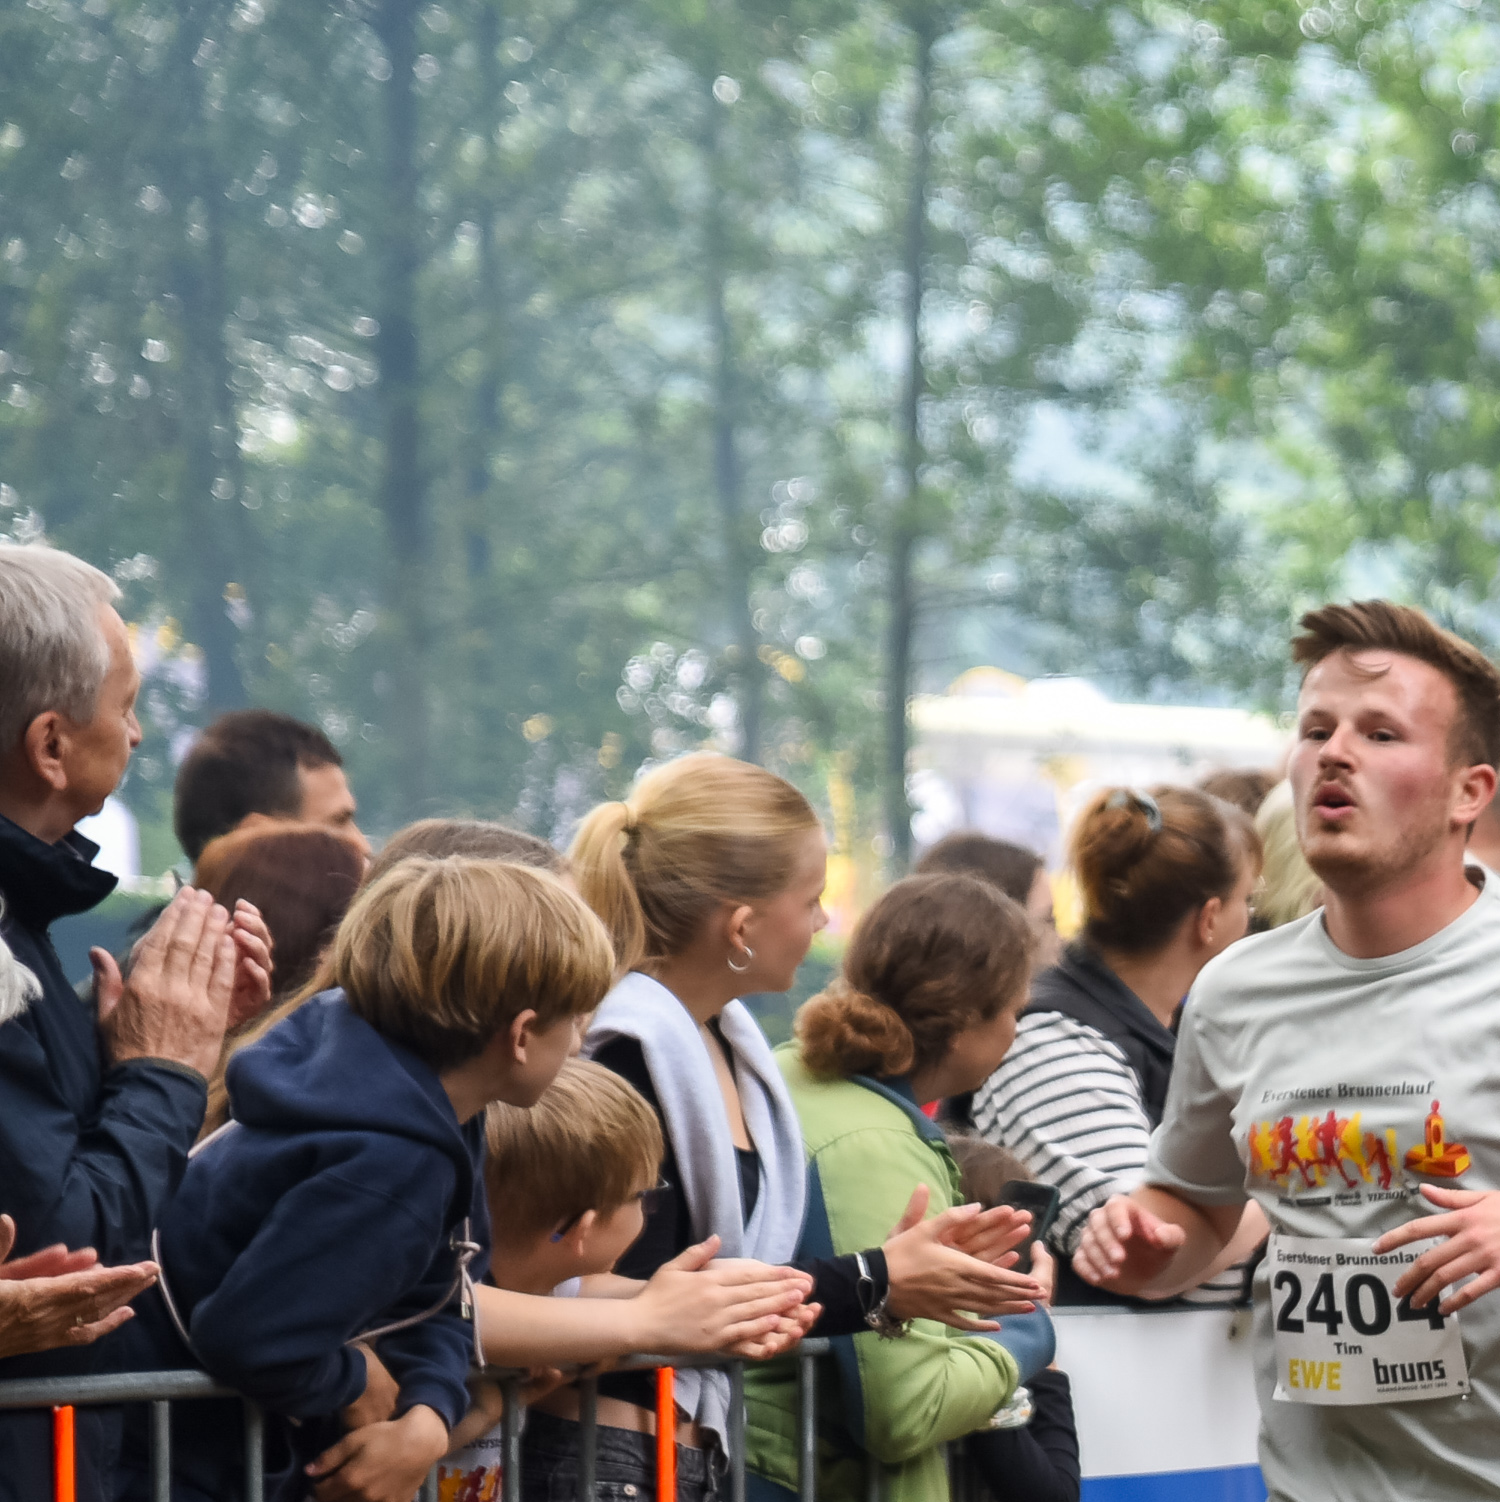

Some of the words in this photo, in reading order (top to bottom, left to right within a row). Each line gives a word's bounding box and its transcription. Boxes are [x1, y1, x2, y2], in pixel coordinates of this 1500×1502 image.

[1261, 1086, 1332, 1103] Everstener
[1337, 1080, 1435, 1099] Brunnenlauf
[1336, 1248, 1430, 1266] Brunnenla
[1274, 1270, 1451, 1336] 2404
[1334, 1342, 1363, 1355] Tim
[1289, 1358, 1342, 1391] EWE
[1373, 1357, 1447, 1386] bruns
